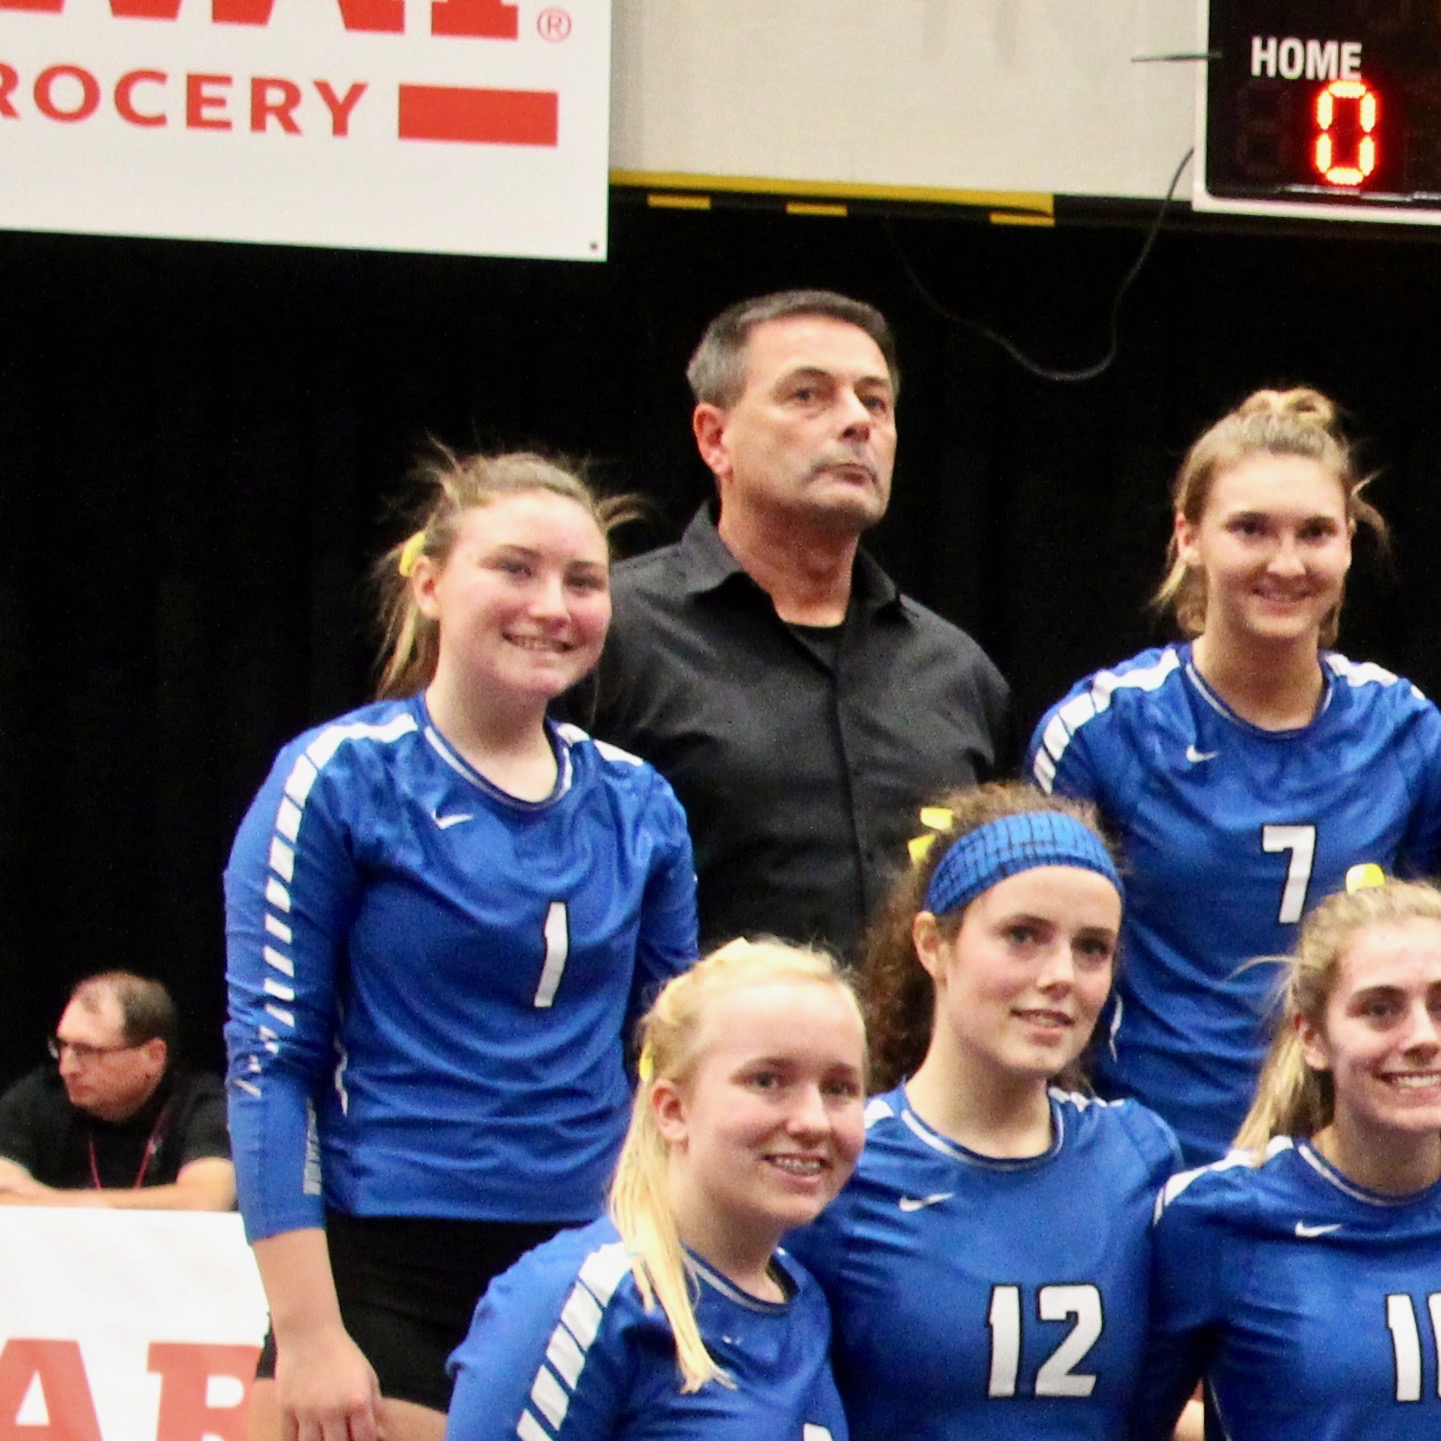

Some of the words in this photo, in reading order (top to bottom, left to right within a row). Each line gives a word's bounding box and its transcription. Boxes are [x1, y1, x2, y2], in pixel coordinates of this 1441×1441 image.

[1252, 36, 1362, 82] HOME
[1316, 78, 1376, 186] 0
[1263, 824, 1316, 924] 7
[533, 901, 570, 1009] 1
[988, 1283, 1103, 1398] 12
